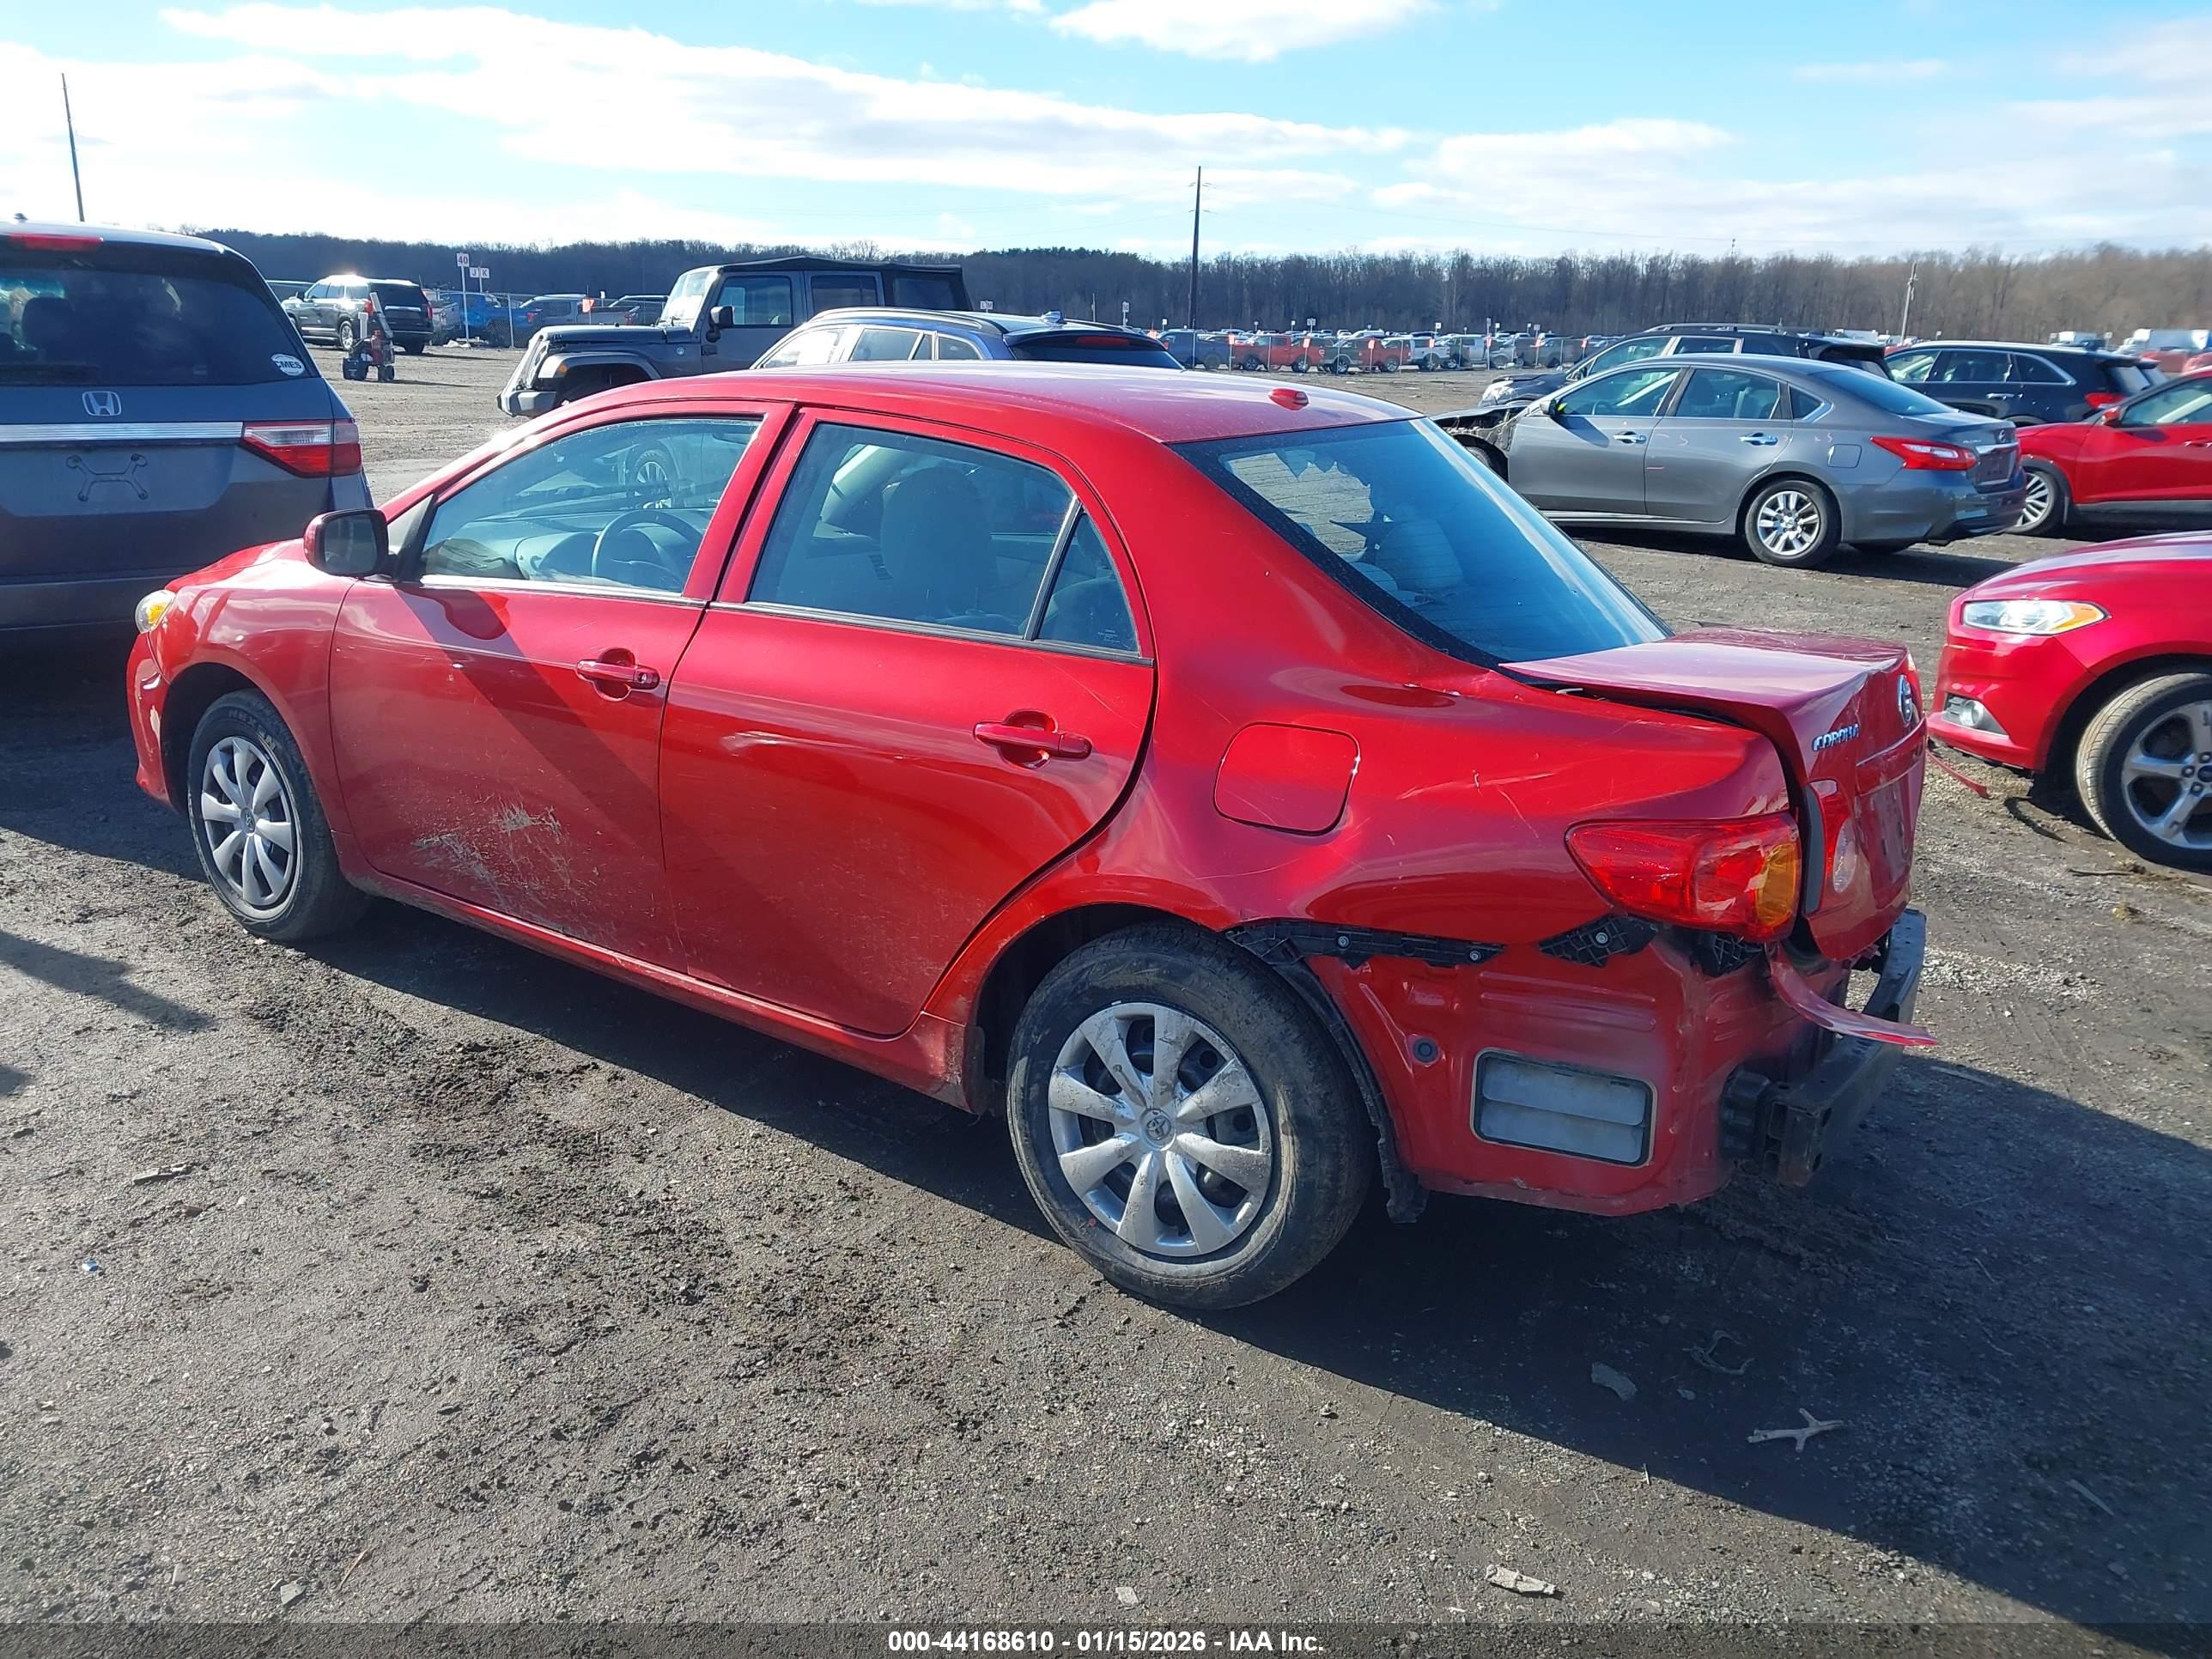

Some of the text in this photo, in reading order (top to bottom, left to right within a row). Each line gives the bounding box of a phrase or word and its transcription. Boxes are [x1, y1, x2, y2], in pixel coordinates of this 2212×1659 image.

[458, 255, 468, 264] 40
[482, 268, 489, 277] K
[1811, 722, 1859, 751] COROLLA
